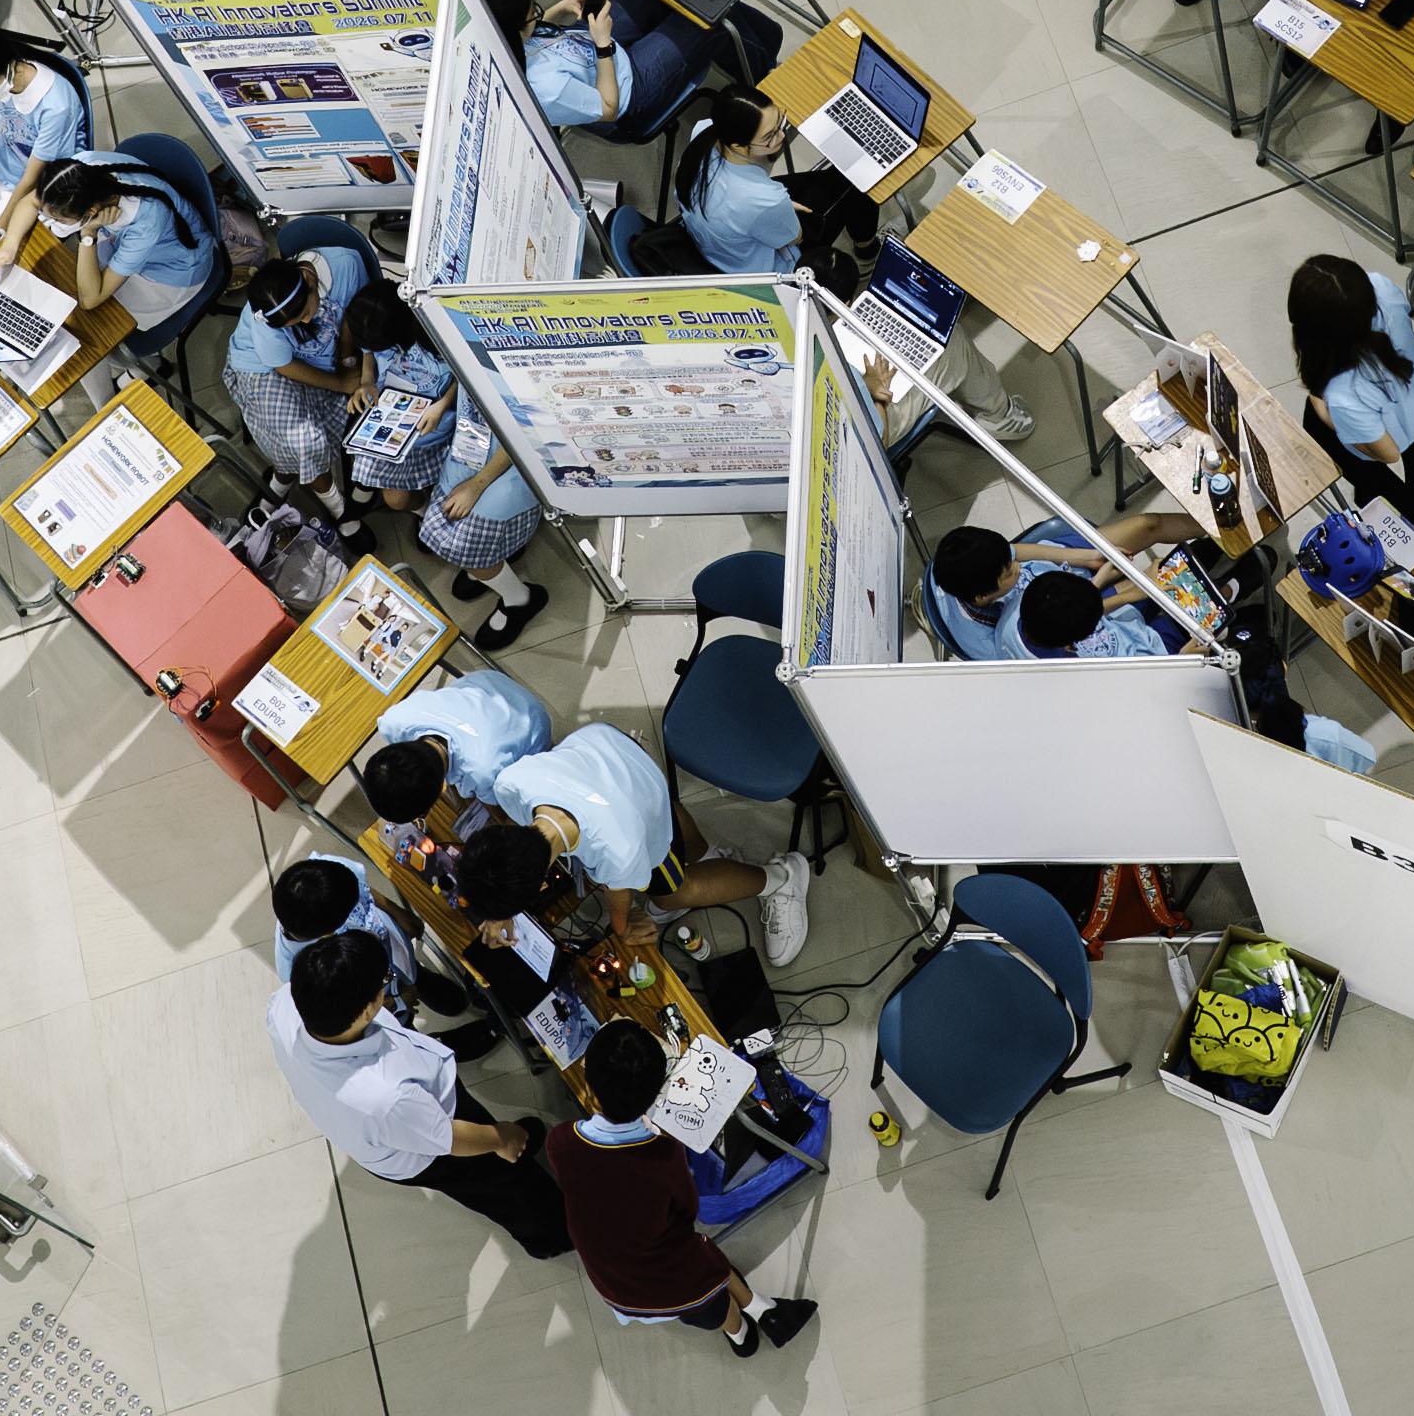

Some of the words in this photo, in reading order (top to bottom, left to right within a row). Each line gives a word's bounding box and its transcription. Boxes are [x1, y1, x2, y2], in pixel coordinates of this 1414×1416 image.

[153, 7, 190, 25] HK
[192, 6, 218, 22] AI
[220, 0, 339, 22] Innovators
[332, 10, 435, 30] 2026.07.11
[1288, 15, 1305, 30] B15
[1274, 20, 1304, 42] SCS12
[449, 119, 471, 236] Innovators
[462, 41, 482, 123] Summit
[991, 165, 1025, 192] ENVS06
[992, 179, 1008, 194] B12
[469, 317, 511, 334] HK
[511, 316, 538, 332] AI
[542, 312, 673, 332] Innovators
[678, 308, 772, 325] Summit
[665, 327, 778, 340] 2026.07.11
[102, 435, 132, 469] HOMEWORK
[131, 466, 149, 486] ROBOT
[1378, 528, 1396, 548] B13
[1383, 516, 1411, 545] SCP10
[253, 698, 287, 729] EDUP02
[269, 694, 287, 710] B02
[535, 1012, 565, 1050] EDUP01
[677, 1113, 701, 1126] Hello
